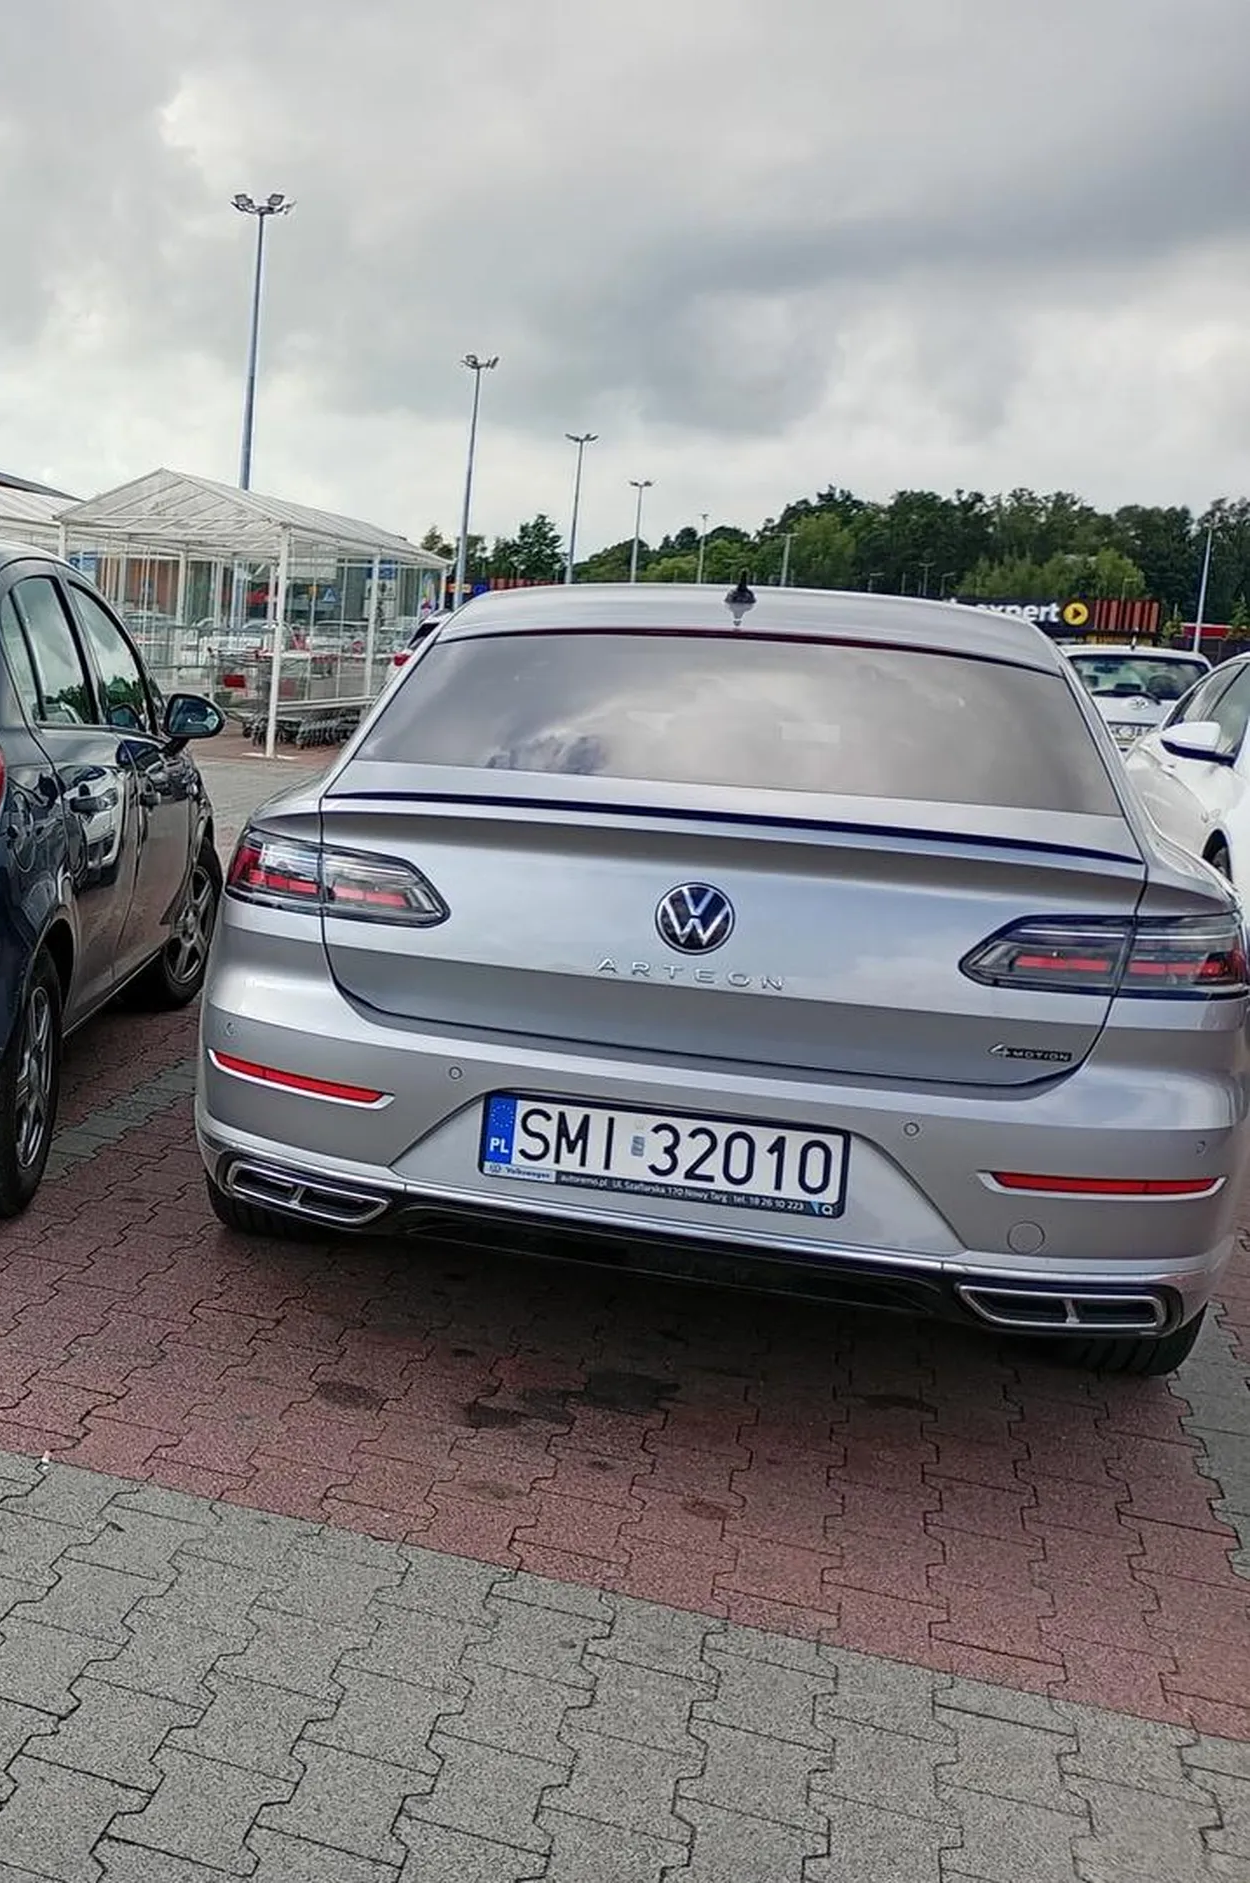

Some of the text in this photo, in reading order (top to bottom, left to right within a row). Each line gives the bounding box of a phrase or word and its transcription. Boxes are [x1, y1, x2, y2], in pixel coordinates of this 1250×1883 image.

[597, 957, 786, 991] ARTEON
[989, 1043, 1070, 1061] 4MOTION
[489, 1137, 509, 1154] PL
[518, 1108, 834, 1196] SMI 32010
